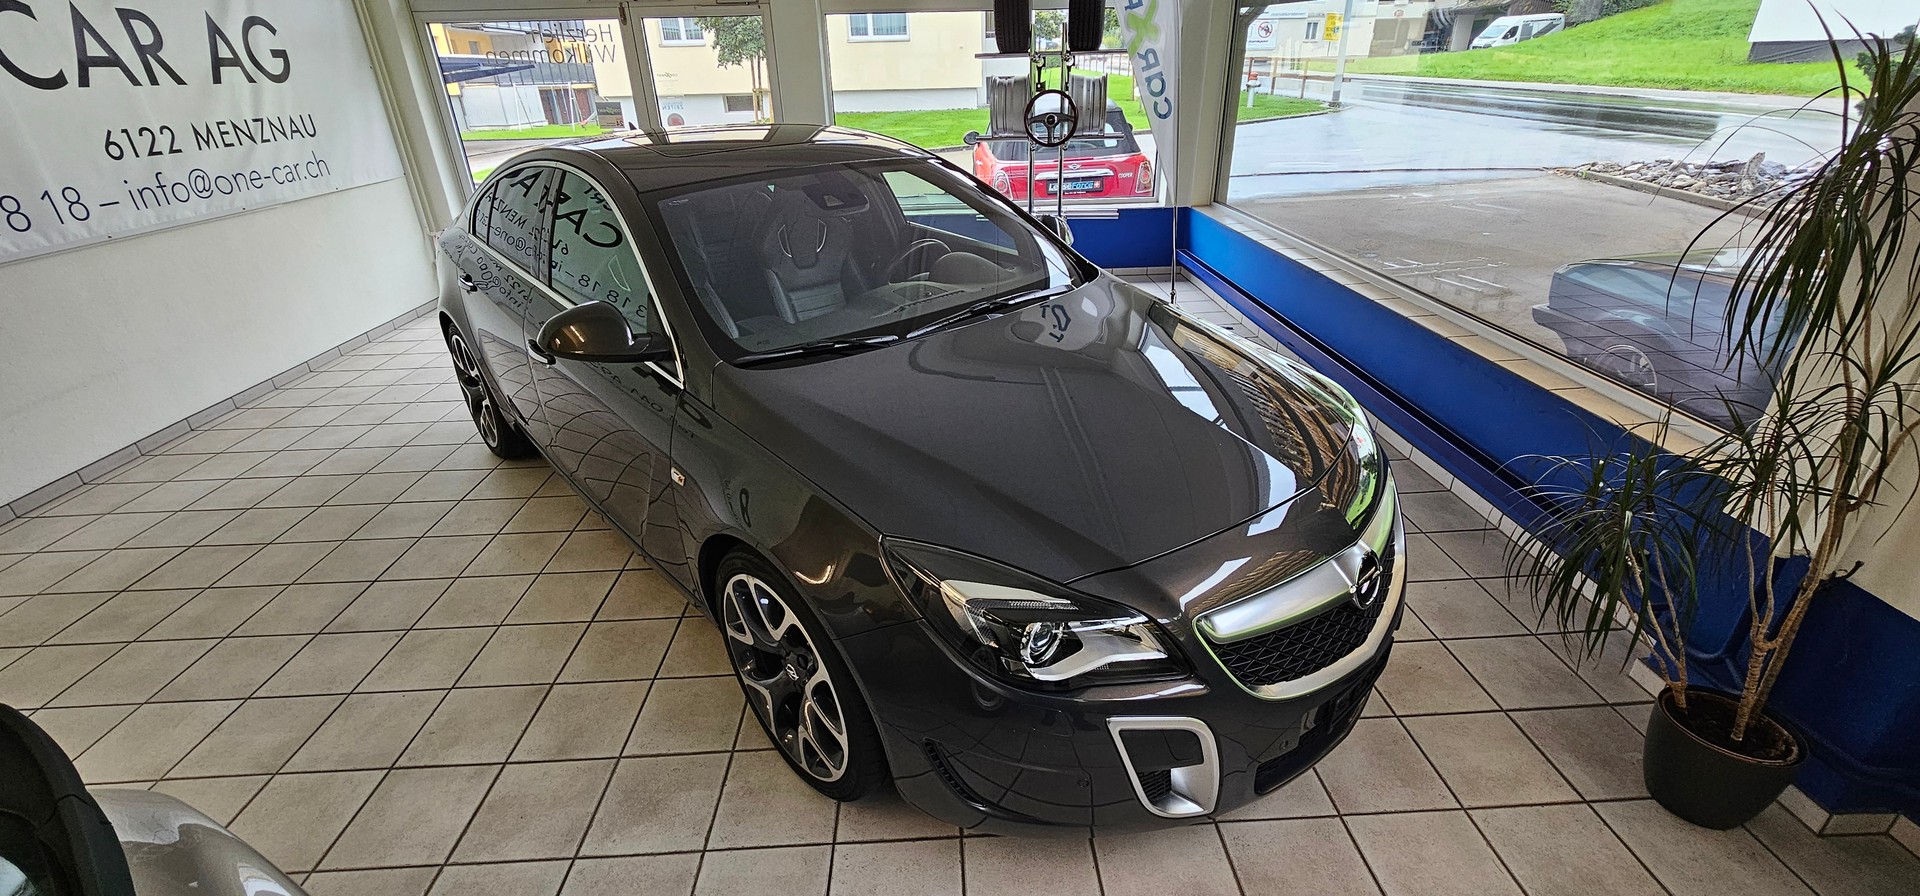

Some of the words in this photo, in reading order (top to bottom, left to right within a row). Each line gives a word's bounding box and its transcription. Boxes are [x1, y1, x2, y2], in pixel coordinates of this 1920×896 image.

[0, 0, 188, 90] CAR
[204, 10, 291, 85] AG
[104, 125, 183, 161] 6122
[190, 113, 317, 151] MENZNAU
[40, 186, 90, 226] 18
[124, 151, 331, 211] info@one-car.ch
